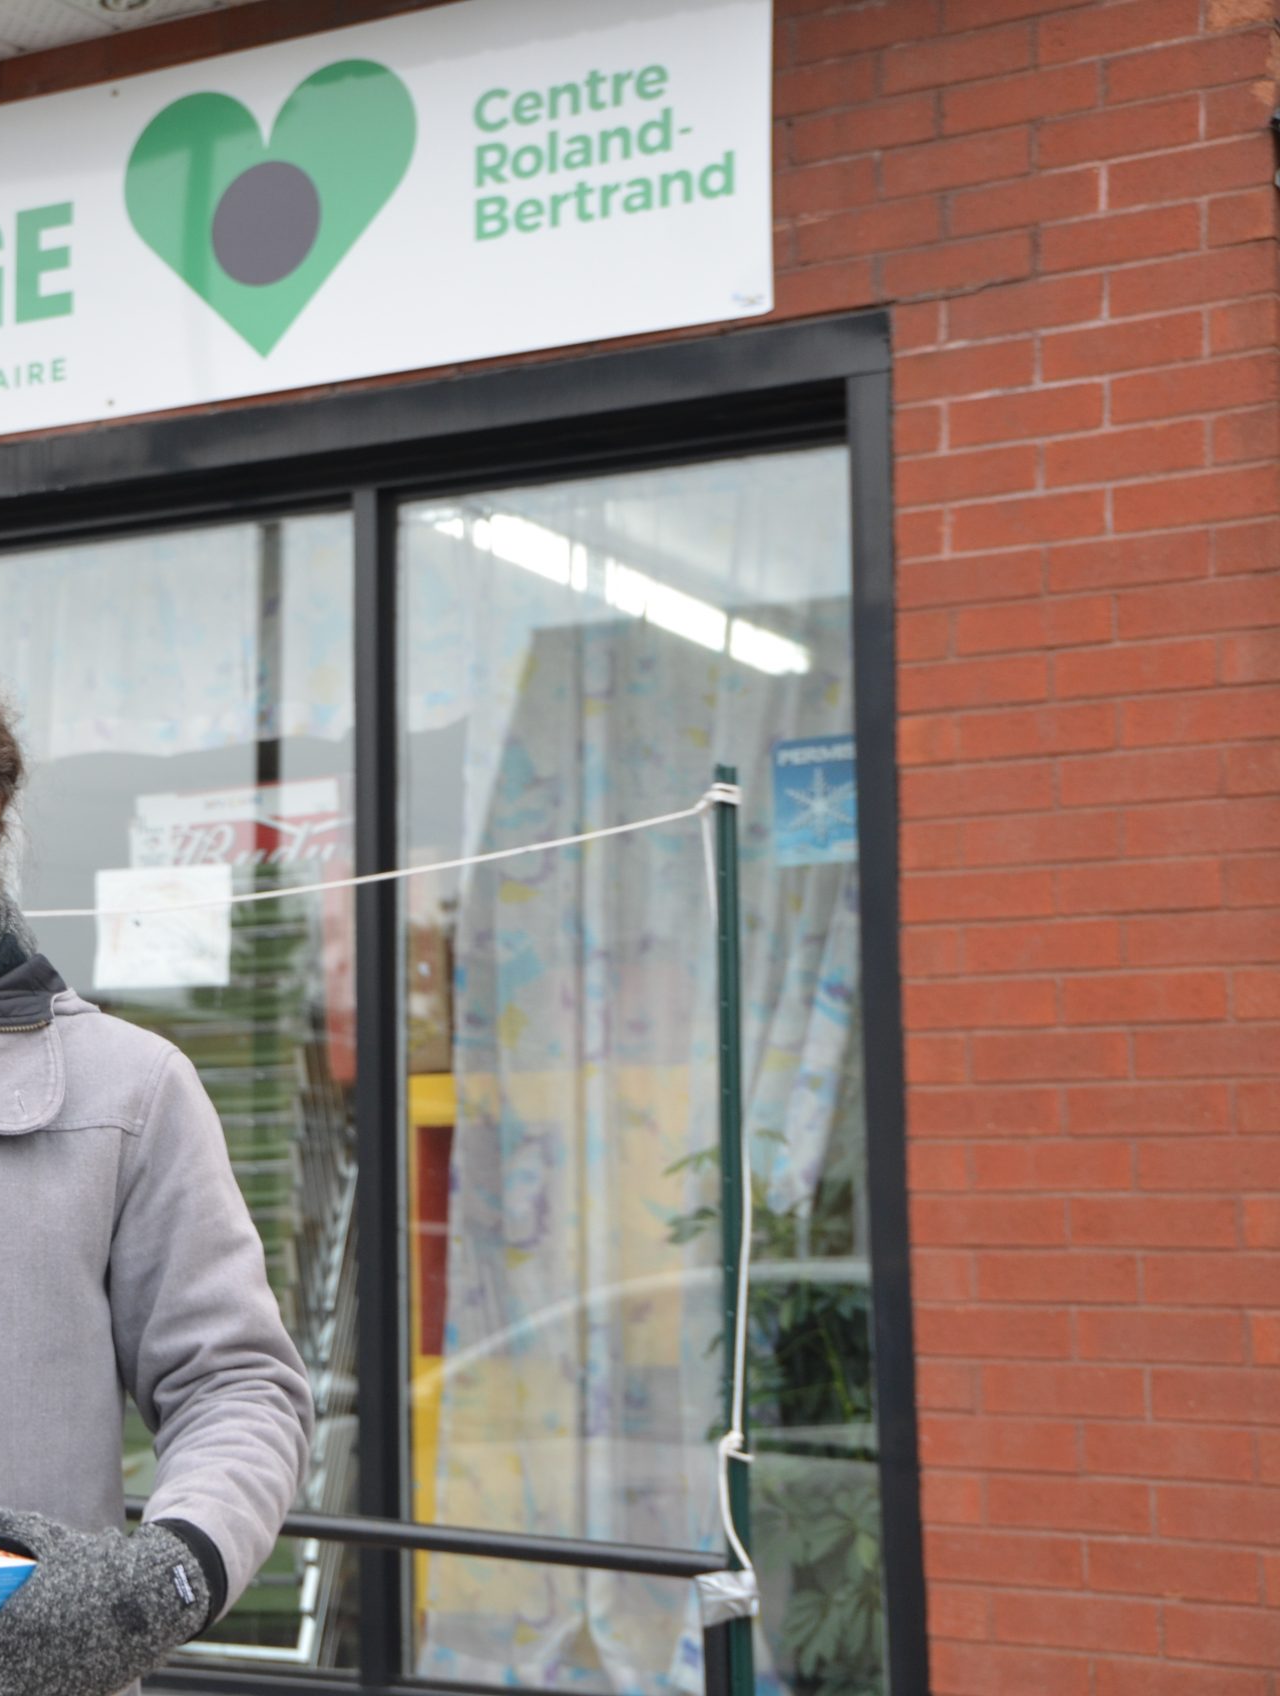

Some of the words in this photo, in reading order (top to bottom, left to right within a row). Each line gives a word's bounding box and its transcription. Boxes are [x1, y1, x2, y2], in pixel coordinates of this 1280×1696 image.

[473, 64, 669, 133] Centre
[475, 107, 693, 188] Roland-
[475, 151, 735, 242] Bertrand
